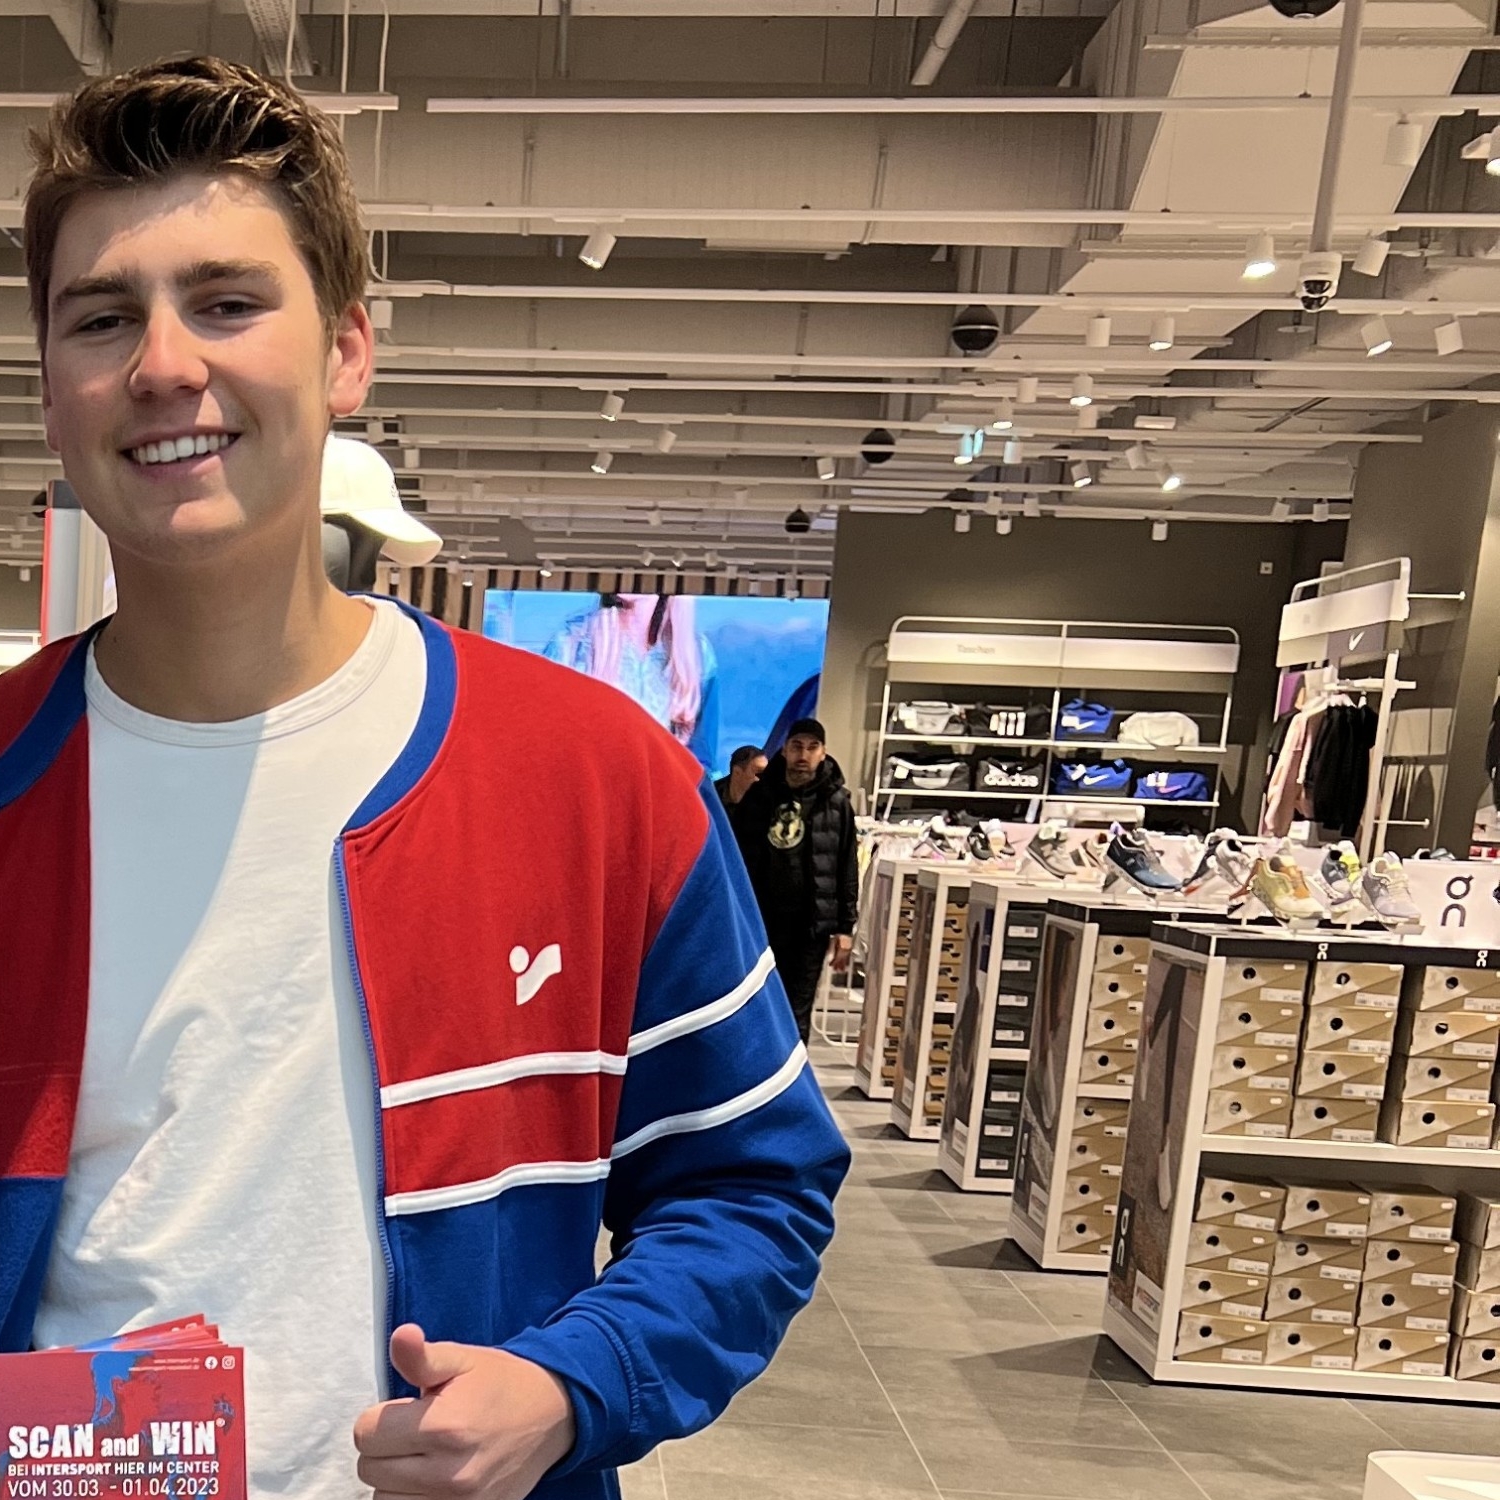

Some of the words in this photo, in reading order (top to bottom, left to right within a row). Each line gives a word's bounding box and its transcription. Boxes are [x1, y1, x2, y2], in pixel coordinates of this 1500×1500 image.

[8, 1423, 94, 1459] SCAN
[100, 1433, 140, 1457] and
[8, 1464, 29, 1477] BEI
[31, 1462, 112, 1476] INTERSPORT
[114, 1462, 145, 1475] HIER
[148, 1461, 164, 1474] IM
[166, 1460, 220, 1474] CENTER
[8, 1479, 47, 1498] VOM
[52, 1478, 104, 1498] 30.03.
[122, 1477, 220, 1497] 01.04.2023
